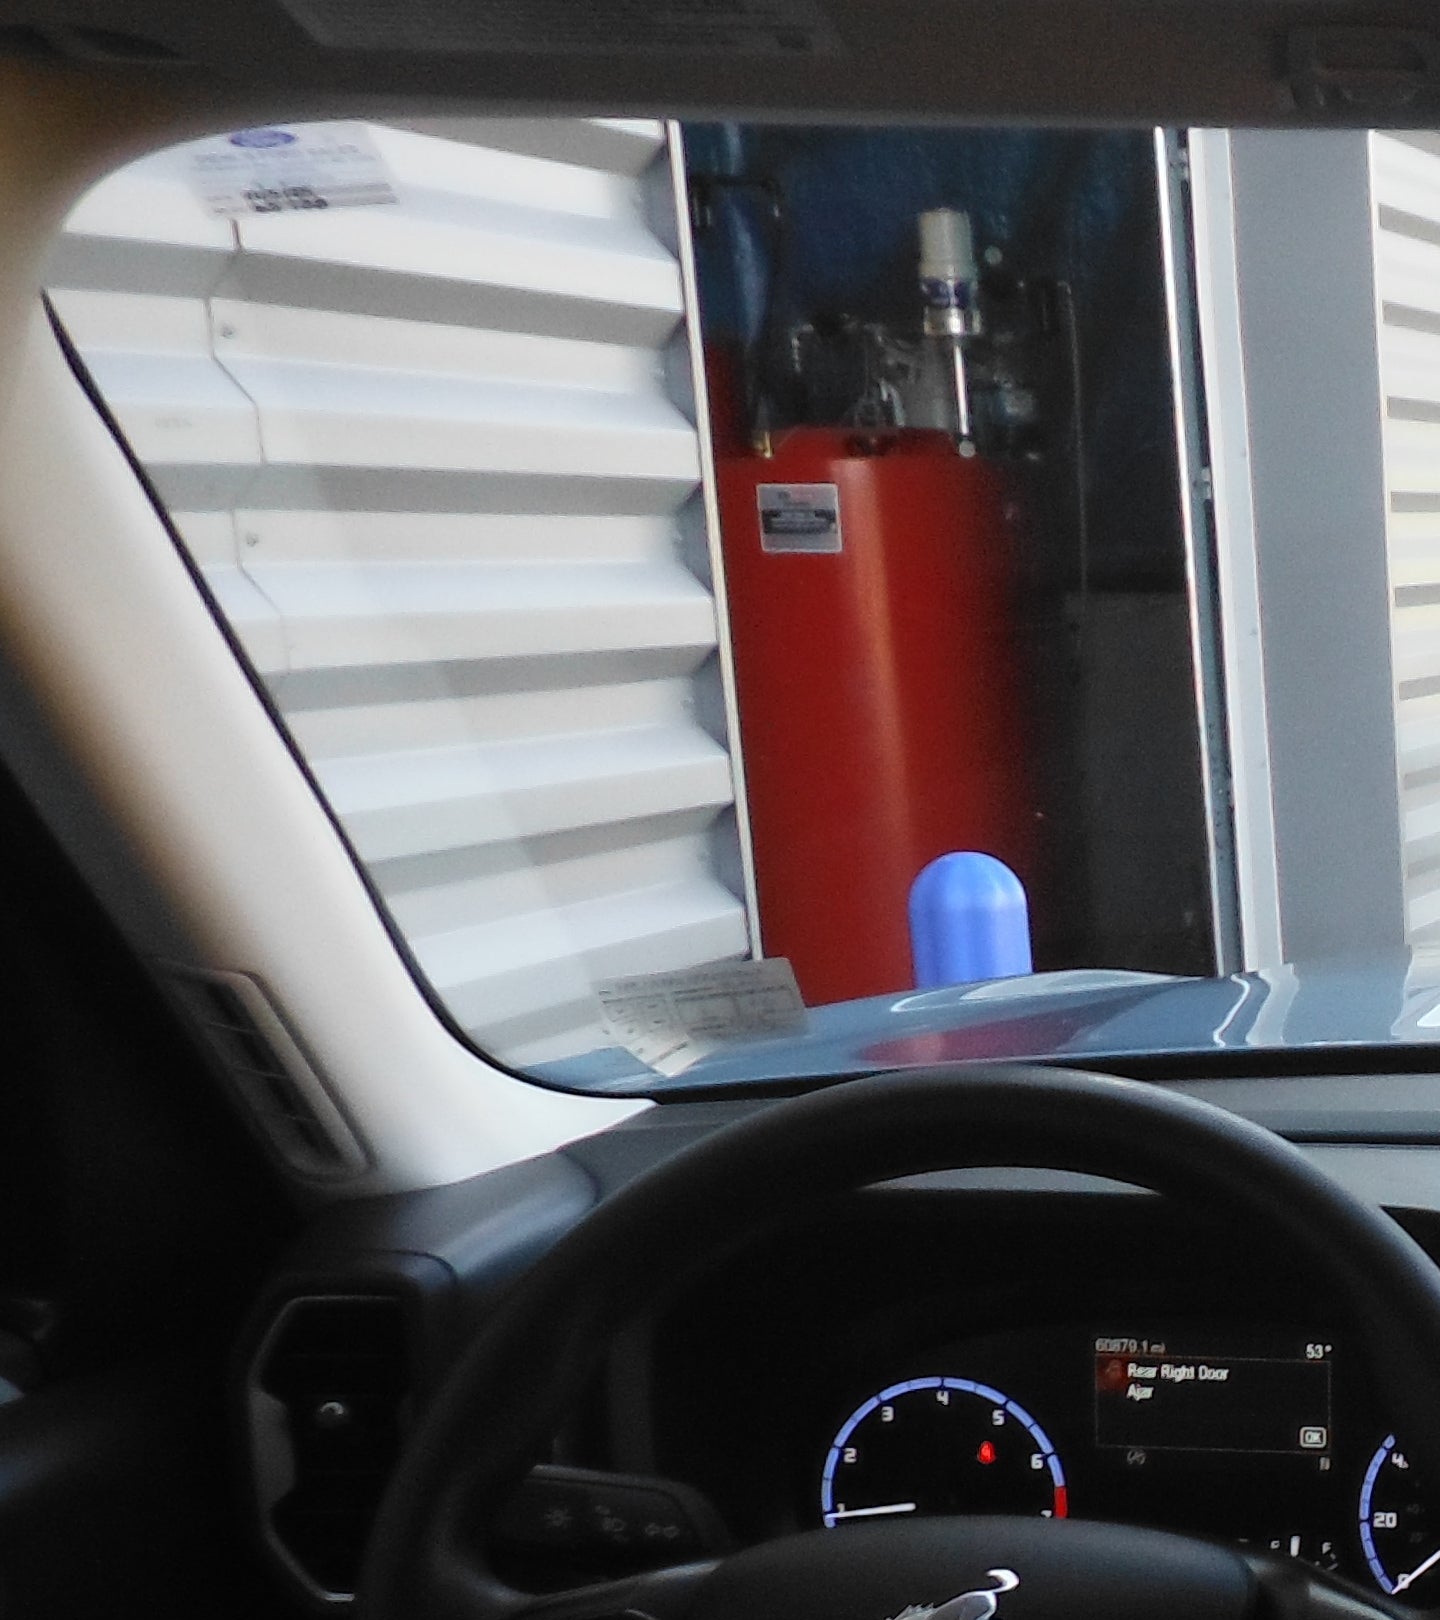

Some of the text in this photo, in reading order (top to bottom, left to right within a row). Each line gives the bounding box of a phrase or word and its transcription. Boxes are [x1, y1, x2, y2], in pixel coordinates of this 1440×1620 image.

[1306, 1344, 1332, 1359] 53°
[1128, 1363, 1230, 1383] Rear Right Door
[936, 1391, 949, 1406] 4
[1127, 1384, 1154, 1401] Ajar
[882, 1406, 894, 1422] 3
[992, 1410, 1005, 1426] 5
[844, 1448, 857, 1463] 2
[1031, 1454, 1044, 1470] 6
[1373, 1512, 1398, 1528] 20
